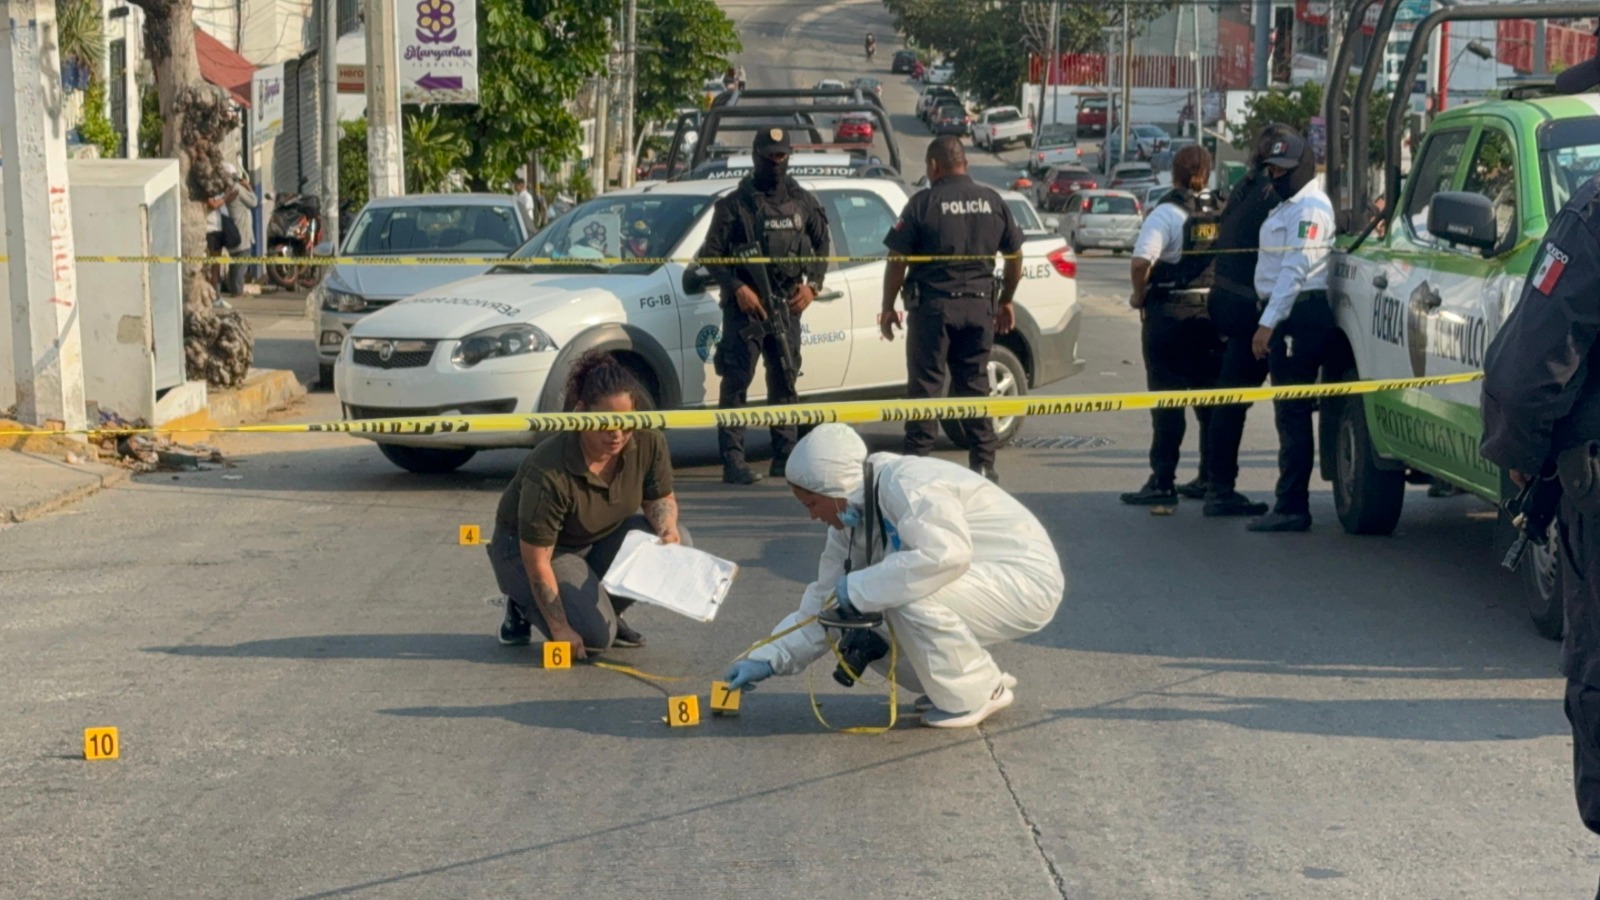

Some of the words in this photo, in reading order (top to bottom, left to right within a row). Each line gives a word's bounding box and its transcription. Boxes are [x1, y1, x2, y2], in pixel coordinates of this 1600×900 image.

[404, 45, 472, 61] Margaritas
[941, 198, 992, 214] POLICÍA
[640, 294, 671, 309] FG-18
[1372, 292, 1405, 348] FUERZA
[801, 331, 846, 346] GUERRERO
[465, 529, 474, 543] 4
[552, 647, 562, 666] 6
[678, 701, 690, 723] 8
[720, 686, 732, 707] 7
[90, 733, 114, 757] 10
